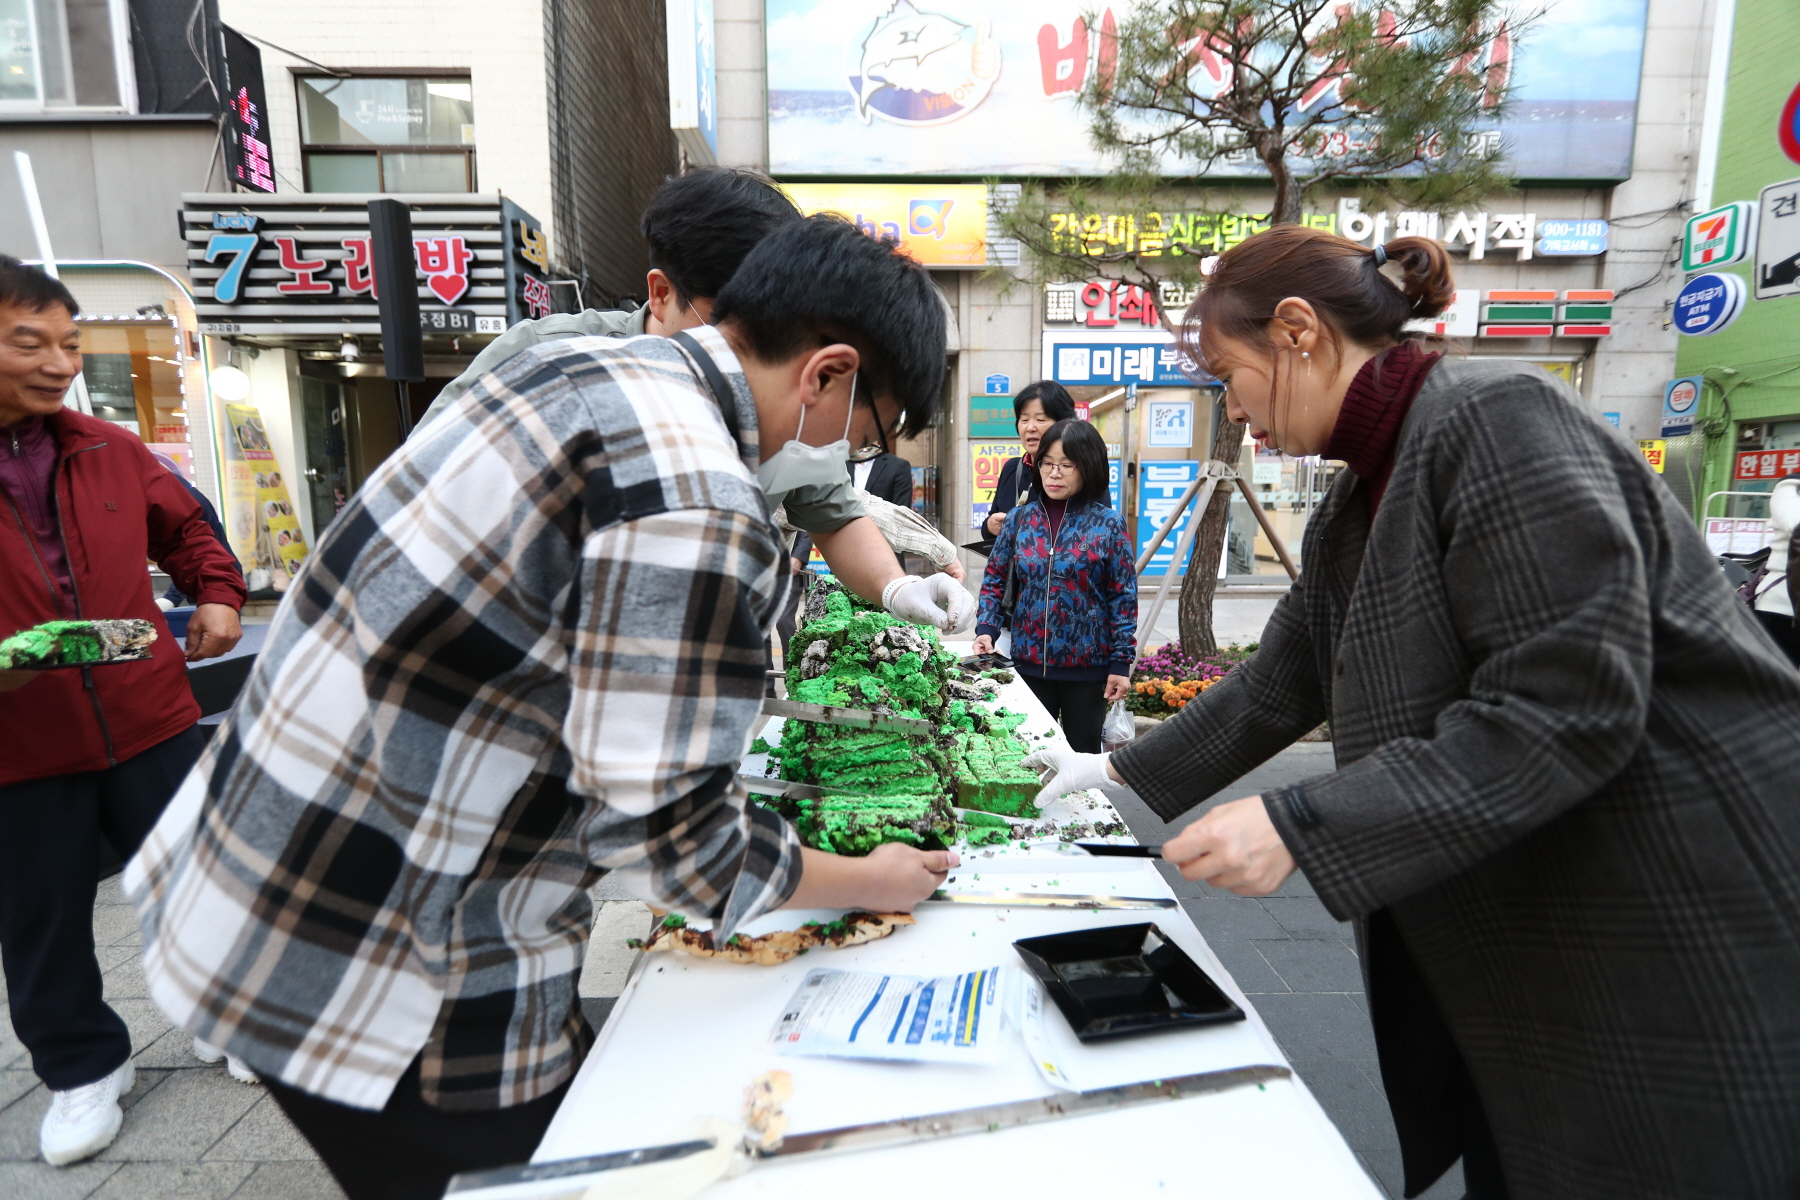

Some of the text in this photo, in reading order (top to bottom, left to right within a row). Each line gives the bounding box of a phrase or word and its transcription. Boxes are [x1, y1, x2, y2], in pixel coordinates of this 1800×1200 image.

[923, 79, 976, 112] VISION
[213, 212, 258, 233] Lucky
[1543, 222, 1603, 237] 900-1181
[518, 218, 549, 275] 노래
[204, 233, 260, 304] 7
[1081, 280, 1159, 326] 인쇄
[1687, 302, 1711, 317] ATM
[450, 311, 469, 329] B1
[1092, 346, 1155, 382] 미래
[994, 383, 1002, 393] 5
[1673, 388, 1695, 402] 담배
[979, 445, 1021, 456] 사무실
